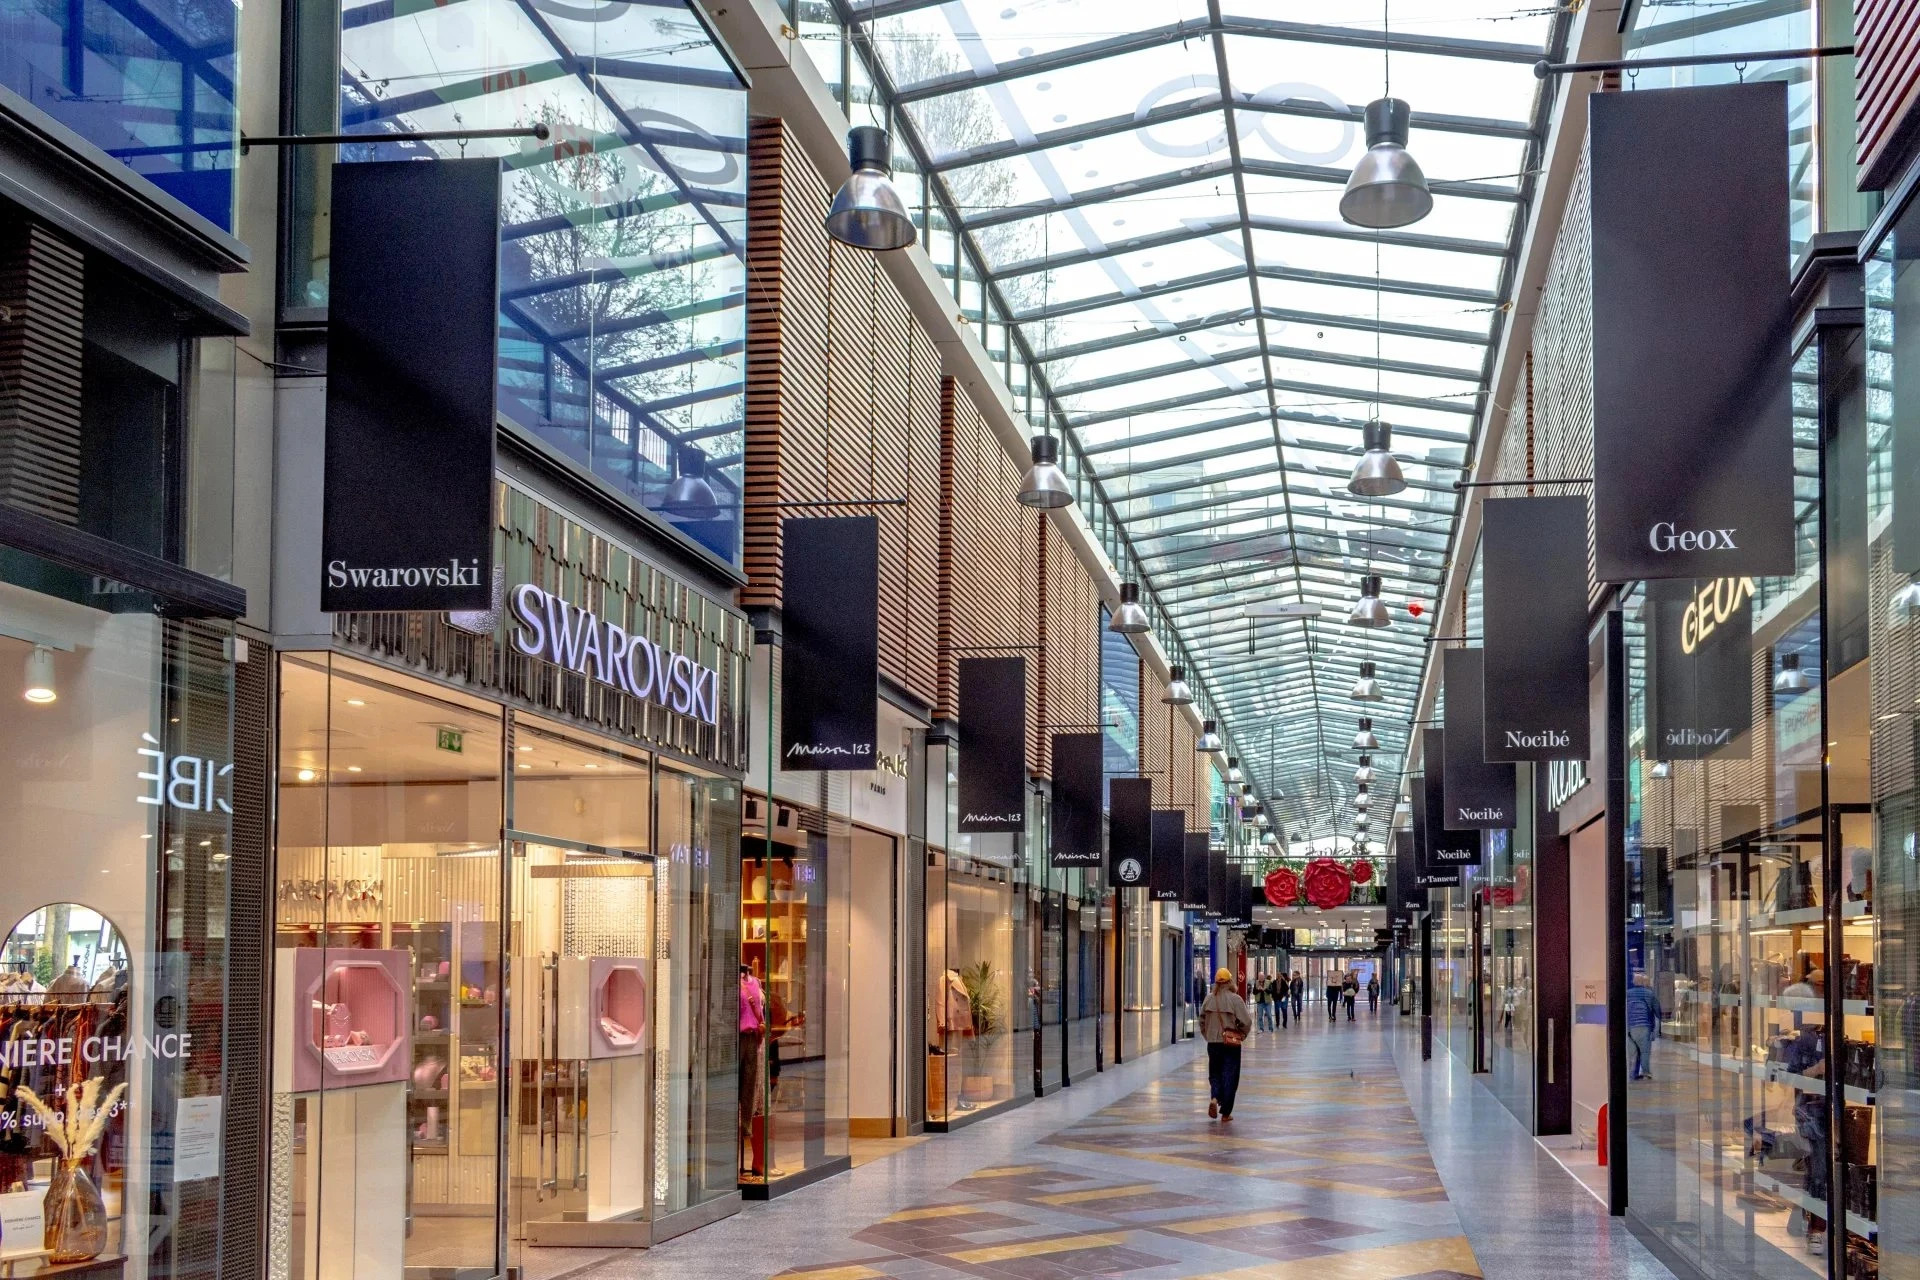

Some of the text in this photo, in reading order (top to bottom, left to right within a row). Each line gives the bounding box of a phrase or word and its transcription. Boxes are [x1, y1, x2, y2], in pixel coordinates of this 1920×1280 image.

[1649, 522, 1739, 552] Geox
[328, 558, 482, 588] Swarovski
[511, 584, 718, 725] SWAROVSKI
[1505, 730, 1570, 748] Nocibé
[786, 742, 871, 758] Maison 123
[962, 812, 1022, 823] Maison 123
[1458, 807, 1503, 820] Nocibé
[1054, 852, 1100, 861] Maison 123
[1436, 849, 1471, 860] Nocibé
[1417, 875, 1459, 884] Le Tanneur
[1157, 890, 1177, 898] Levi's
[83, 1033, 192, 1063] CHANCE
